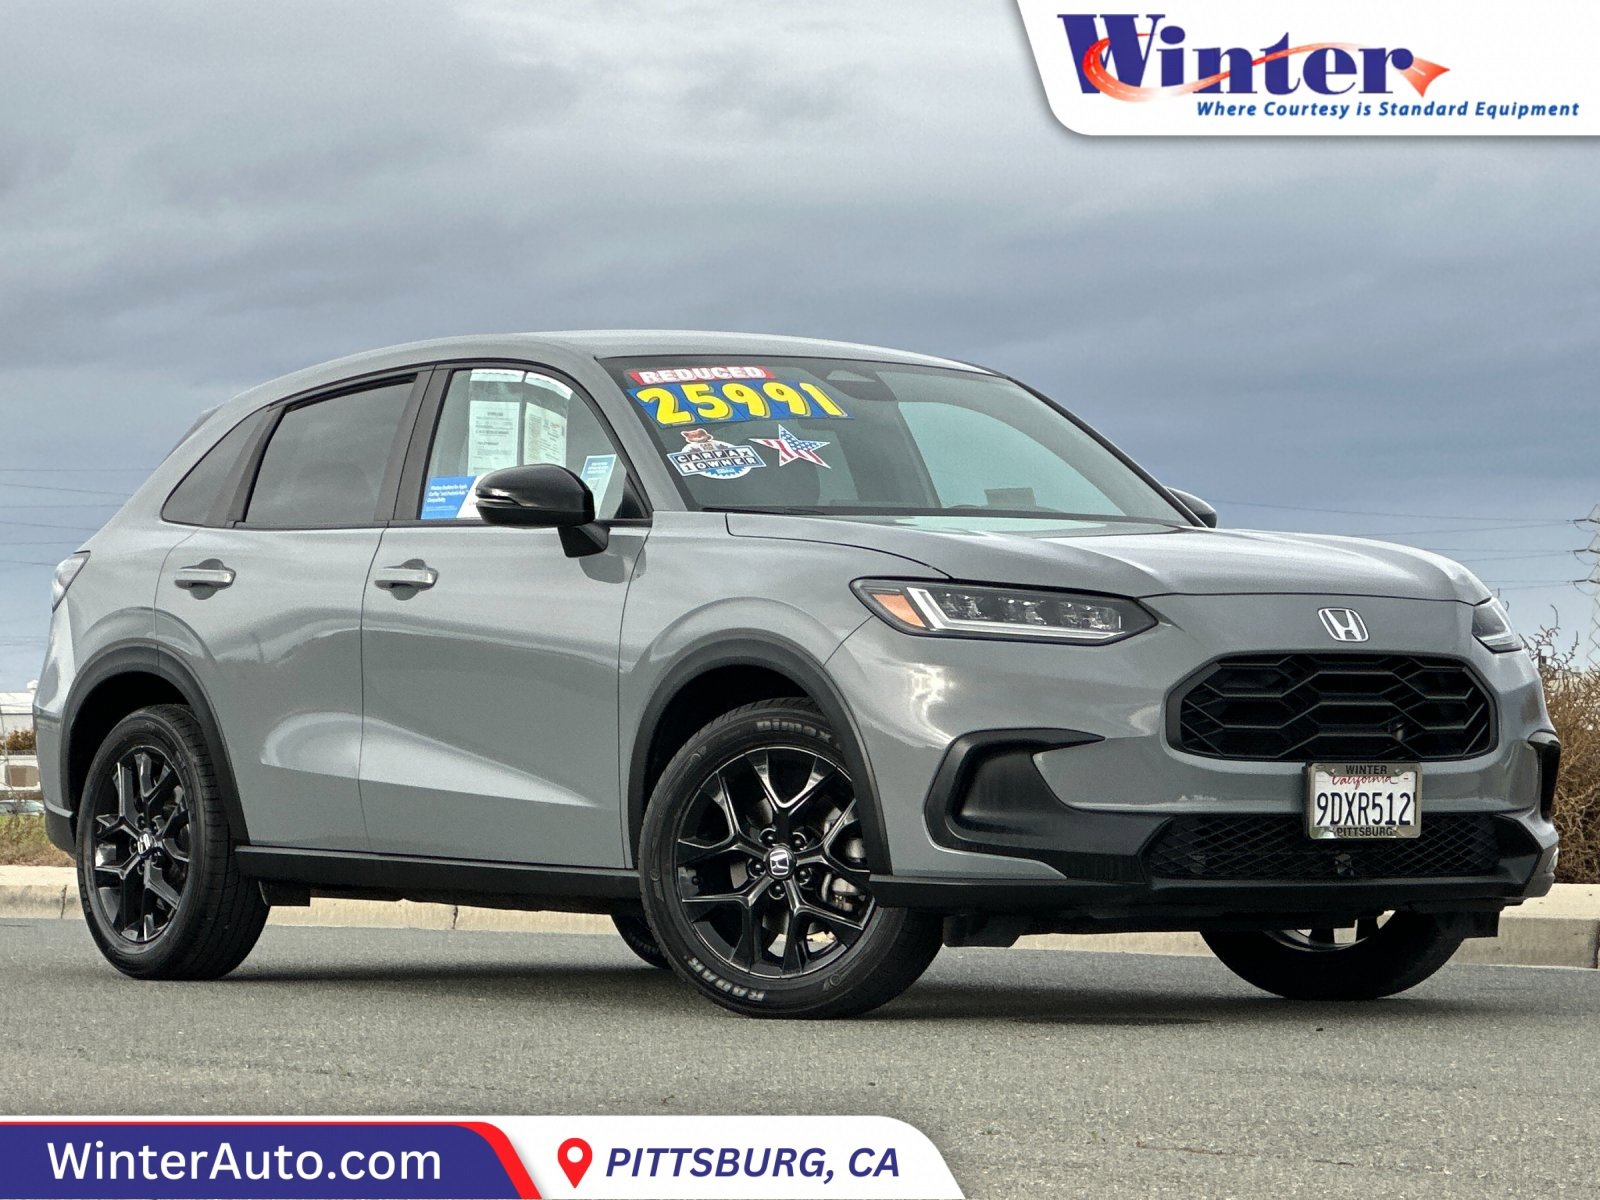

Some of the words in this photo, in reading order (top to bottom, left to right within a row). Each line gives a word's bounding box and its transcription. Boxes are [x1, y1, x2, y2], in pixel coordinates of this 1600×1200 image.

[639, 366, 766, 384] REDUCED
[636, 382, 844, 424] 25991
[677, 449, 750, 463] CARFAX
[696, 457, 756, 469] OWNER
[1345, 764, 1388, 775] WINTER
[1332, 775, 1398, 790] California
[1316, 792, 1411, 826] 9DXR512
[1337, 826, 1393, 837] PITTSBURG
